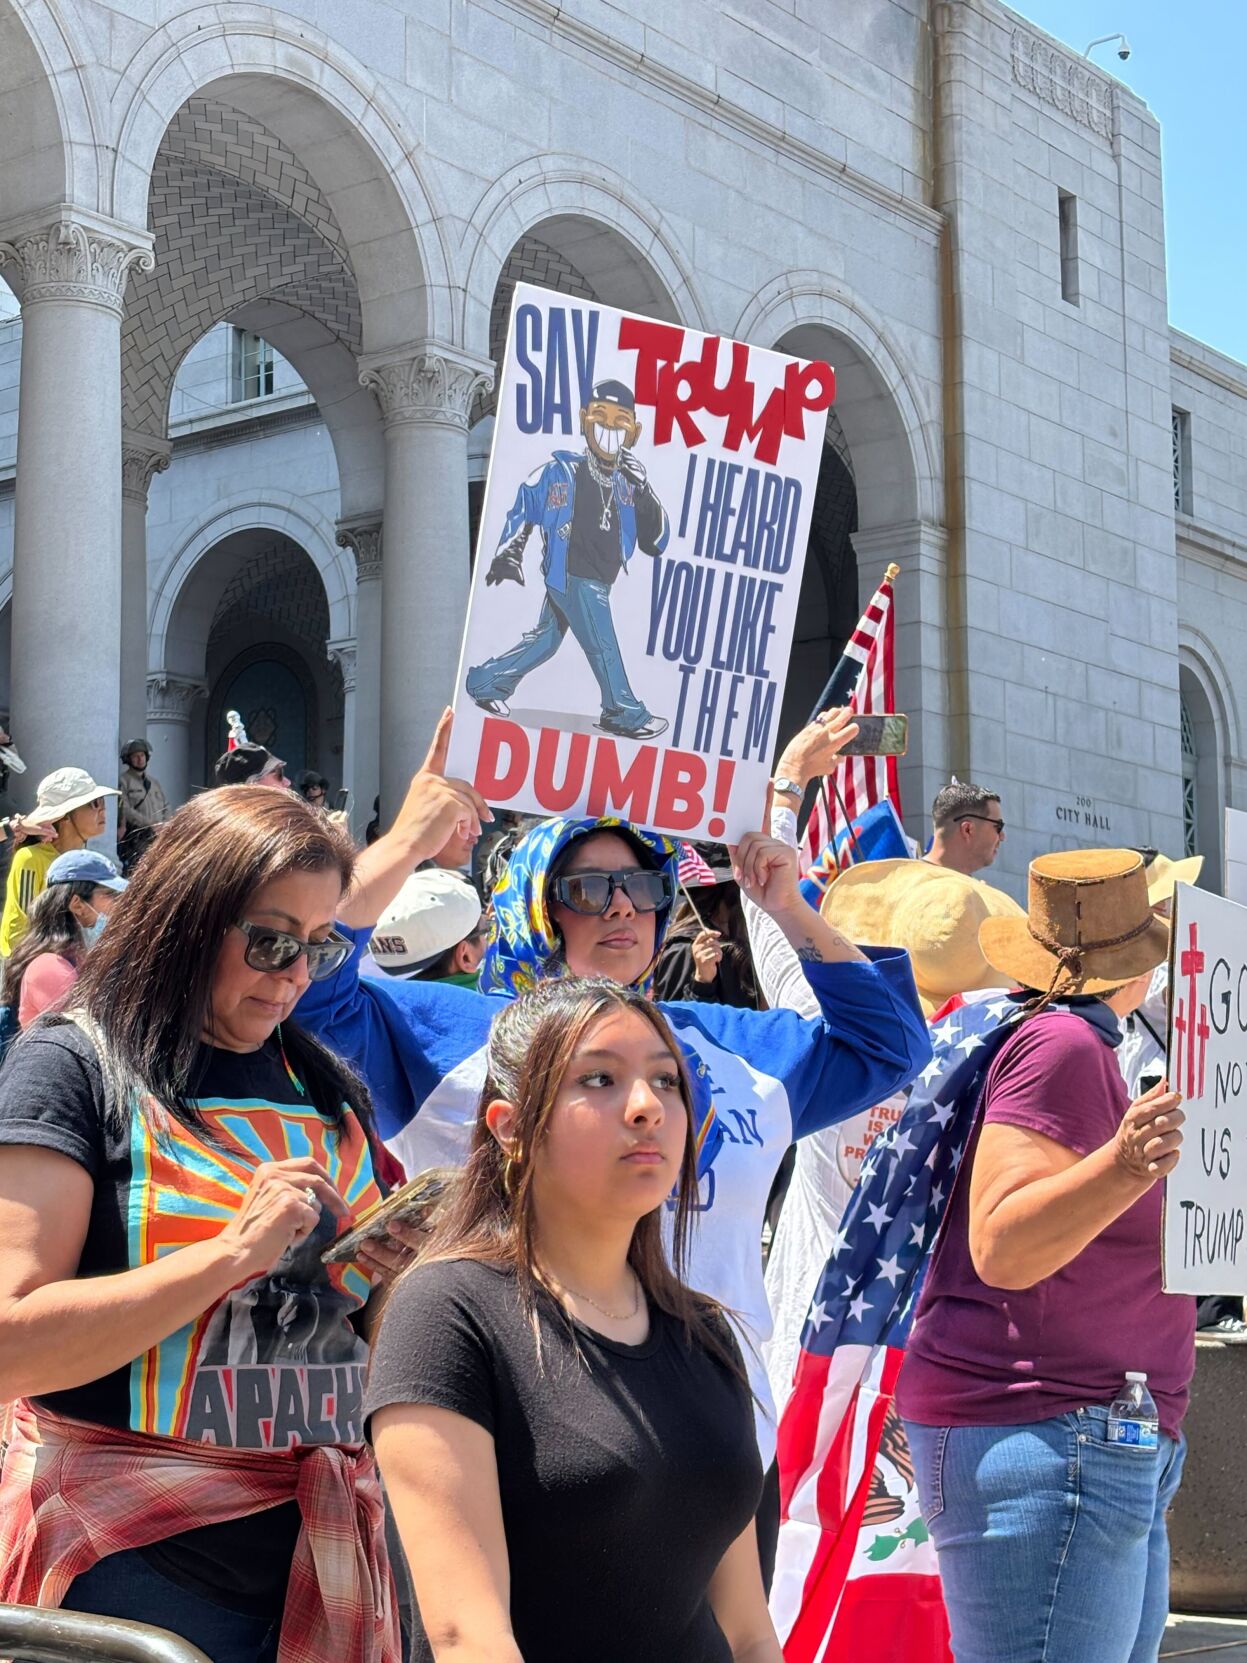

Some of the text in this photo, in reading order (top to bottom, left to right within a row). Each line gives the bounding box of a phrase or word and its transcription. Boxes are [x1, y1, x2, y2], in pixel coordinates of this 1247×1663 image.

[515, 303, 836, 466] SAY TRUMP
[679, 454, 802, 576] I HEARD
[646, 557, 784, 680] YOU LIKE
[672, 664, 777, 764] THEM
[473, 716, 737, 838] DUMB!
[1056, 806, 1111, 831] CITY HALL
[1201, 1127, 1232, 1181] US
[1179, 1200, 1244, 1269] TRUMP
